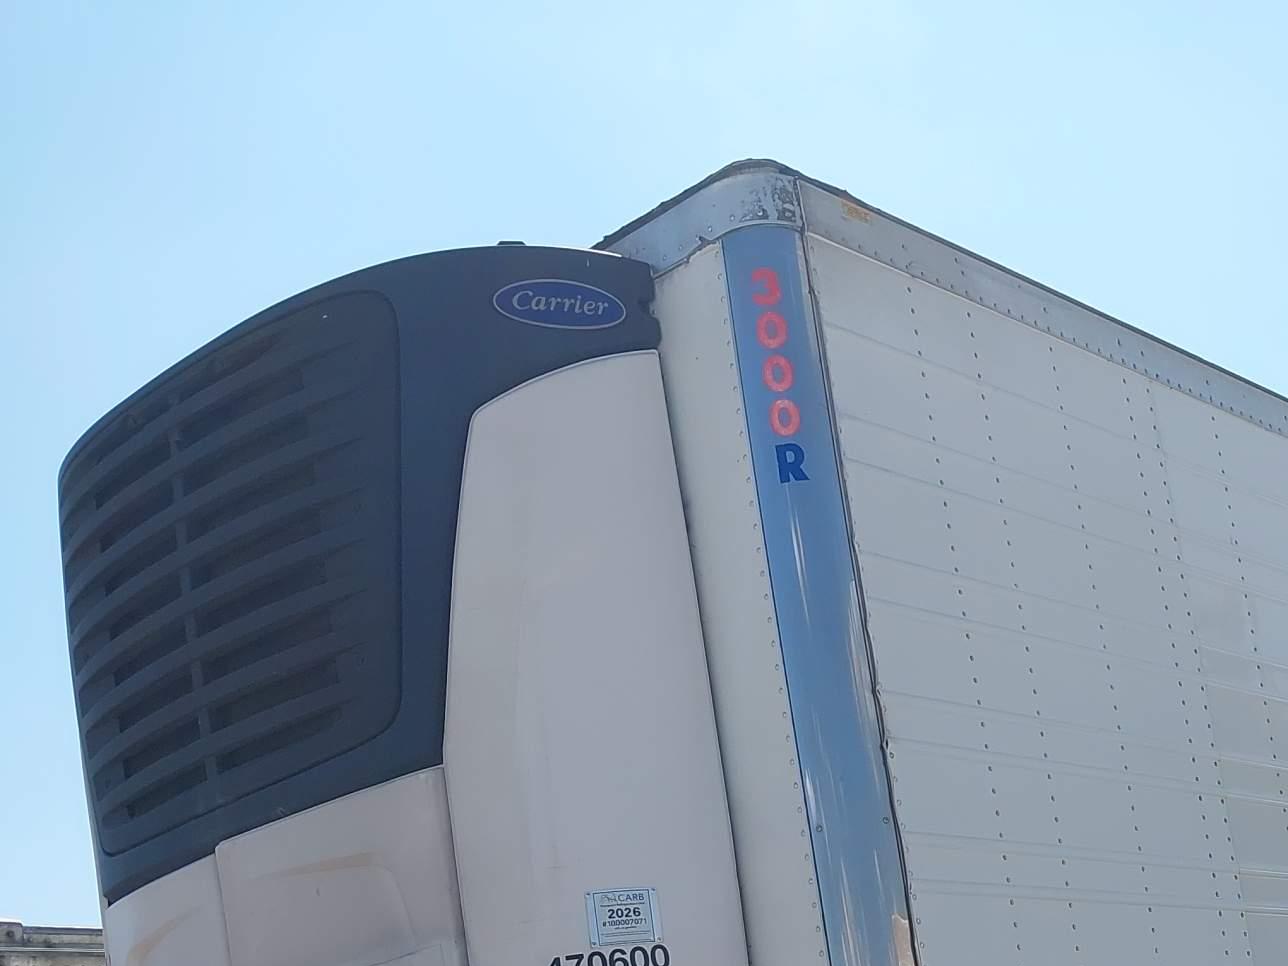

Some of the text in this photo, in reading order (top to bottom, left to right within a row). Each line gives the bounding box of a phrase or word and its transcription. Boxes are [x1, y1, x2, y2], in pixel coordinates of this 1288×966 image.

[512, 290, 609, 315] Carrier
[752, 266, 810, 483] 3000R
[617, 892, 645, 902] CARB
[607, 907, 641, 919] 2026
